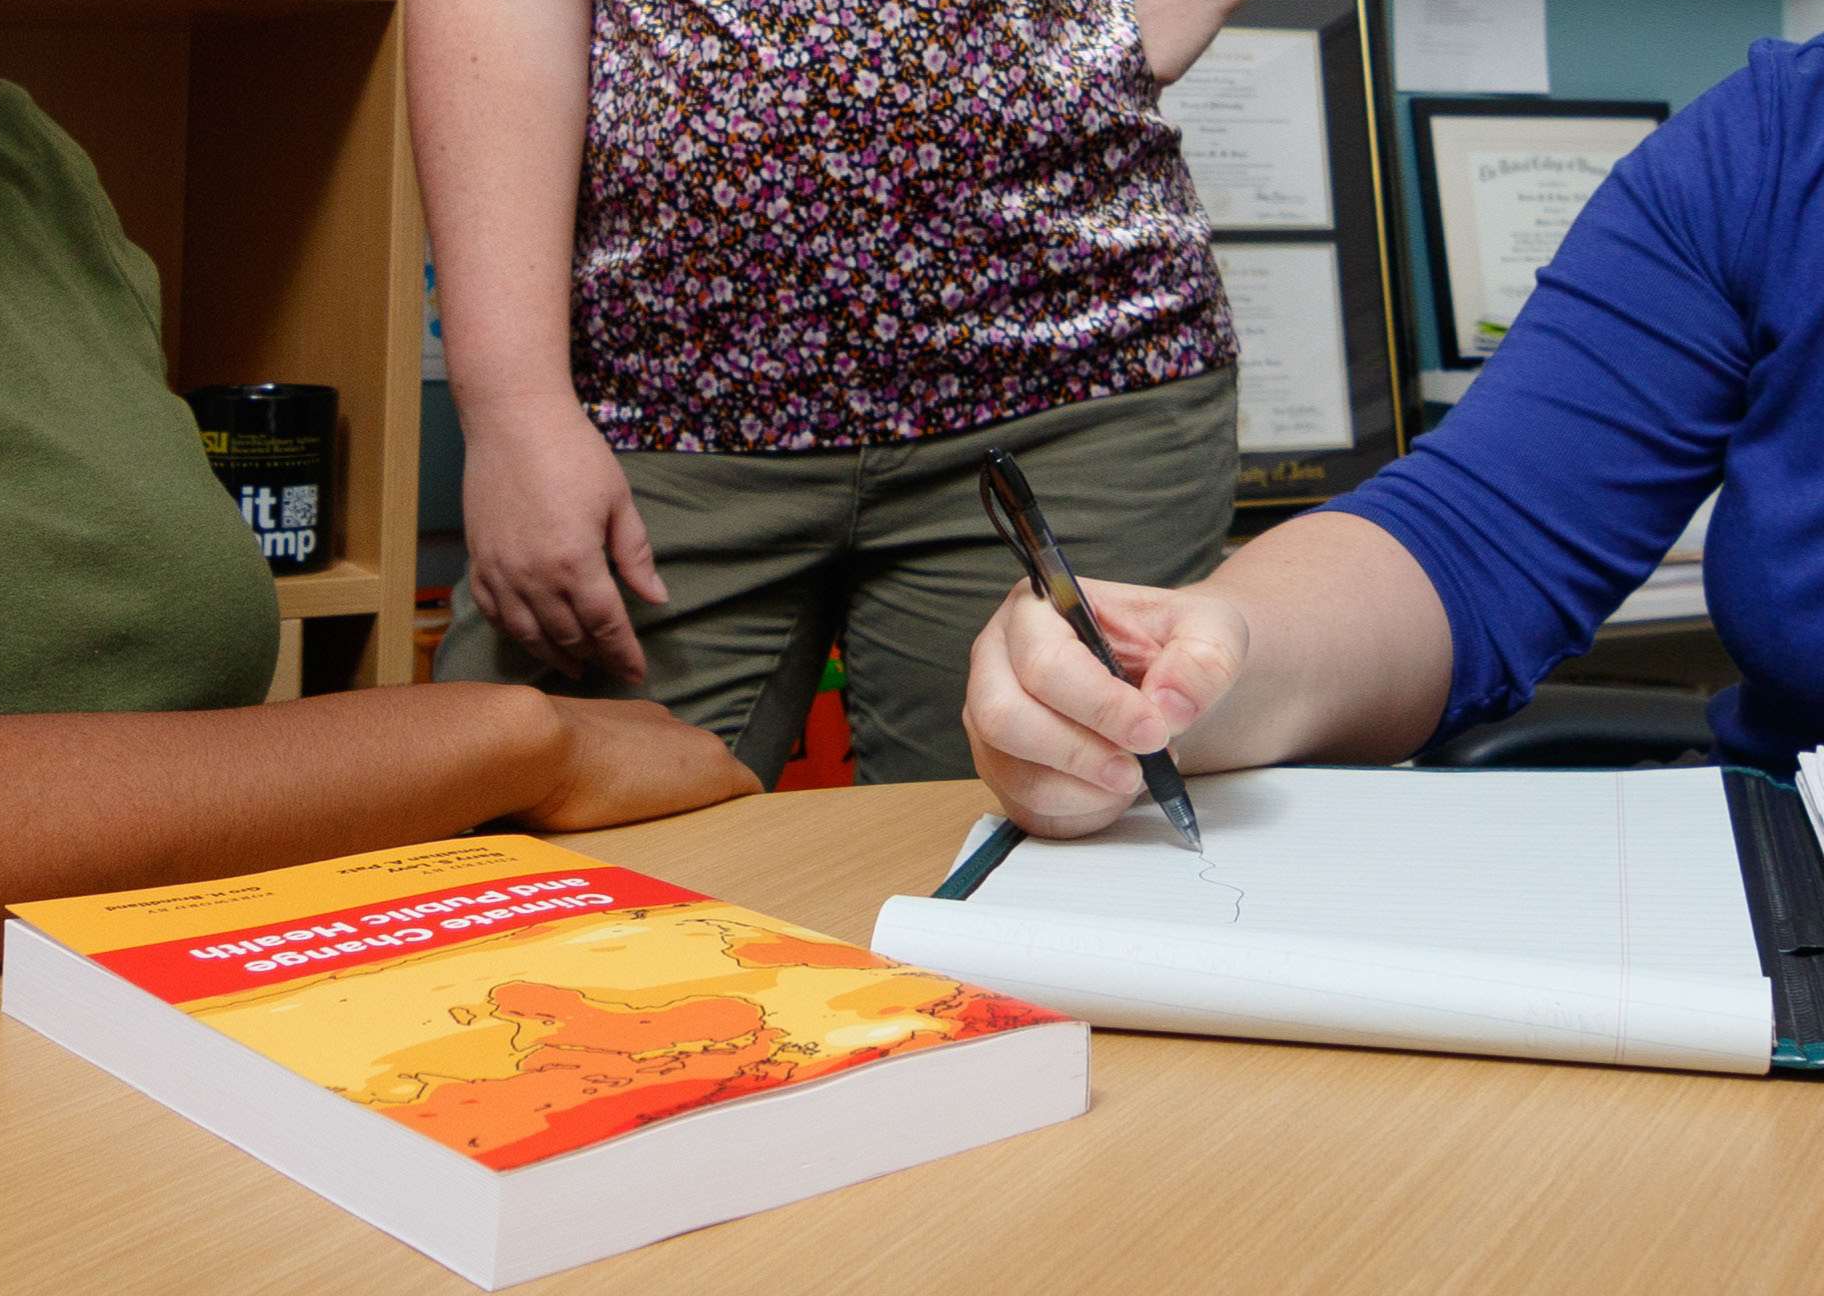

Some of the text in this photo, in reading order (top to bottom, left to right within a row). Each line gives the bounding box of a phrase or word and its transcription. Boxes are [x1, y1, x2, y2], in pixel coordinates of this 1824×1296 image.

[335, 847, 490, 875] Jonathan Patz
[387, 852, 505, 874] Barry Levy
[449, 857, 519, 870] EDITED
[104, 894, 205, 913] Brundtland
[175, 892, 274, 911] FOREWORD
[188, 876, 591, 960] and Public Health
[243, 892, 614, 972] Climate Change
